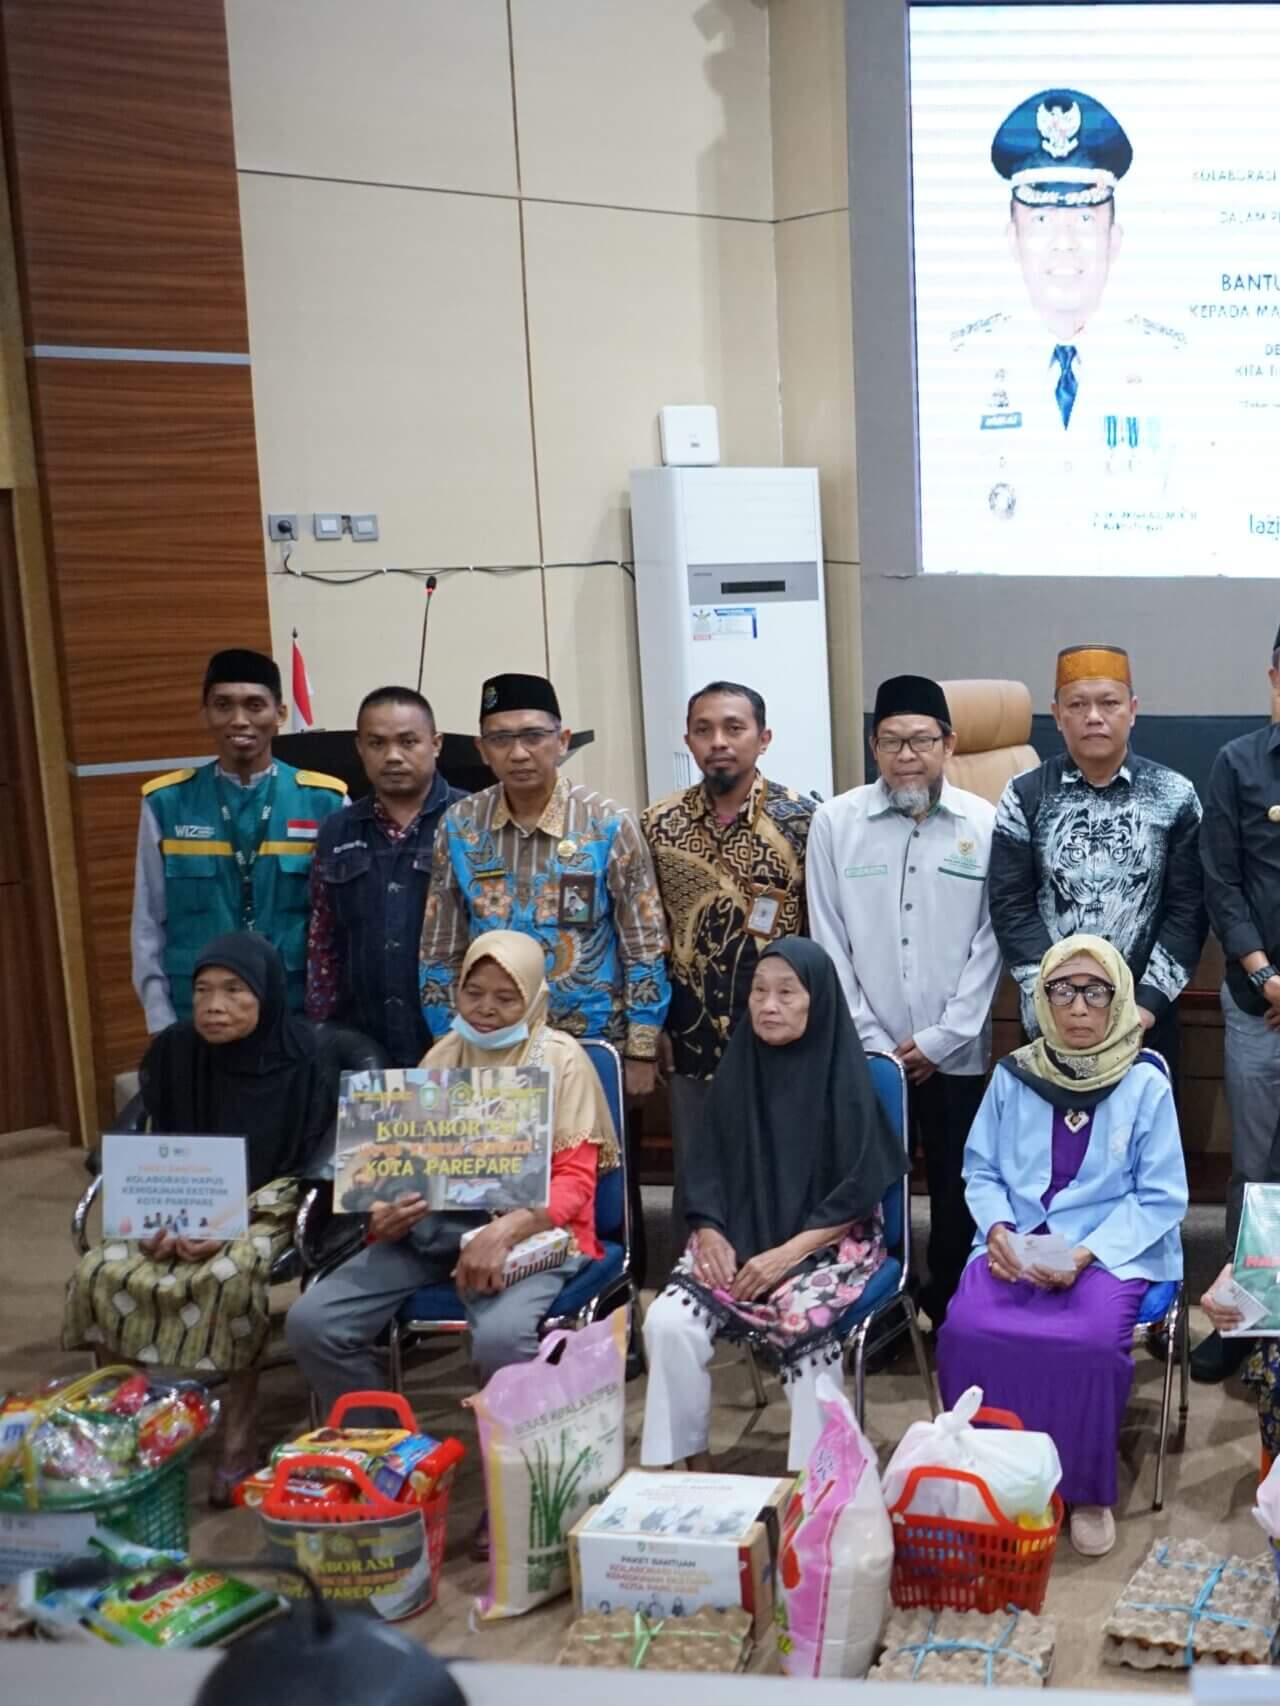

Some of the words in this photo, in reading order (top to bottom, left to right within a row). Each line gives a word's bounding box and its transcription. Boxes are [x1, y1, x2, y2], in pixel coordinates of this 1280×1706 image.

[1189, 304, 1250, 319] KEPADA
[1234, 365, 1264, 377] KITA
[376, 1119, 518, 1139] KOLABORSI
[366, 1158, 415, 1178] KOTA
[423, 1156, 523, 1176] PAREPARE
